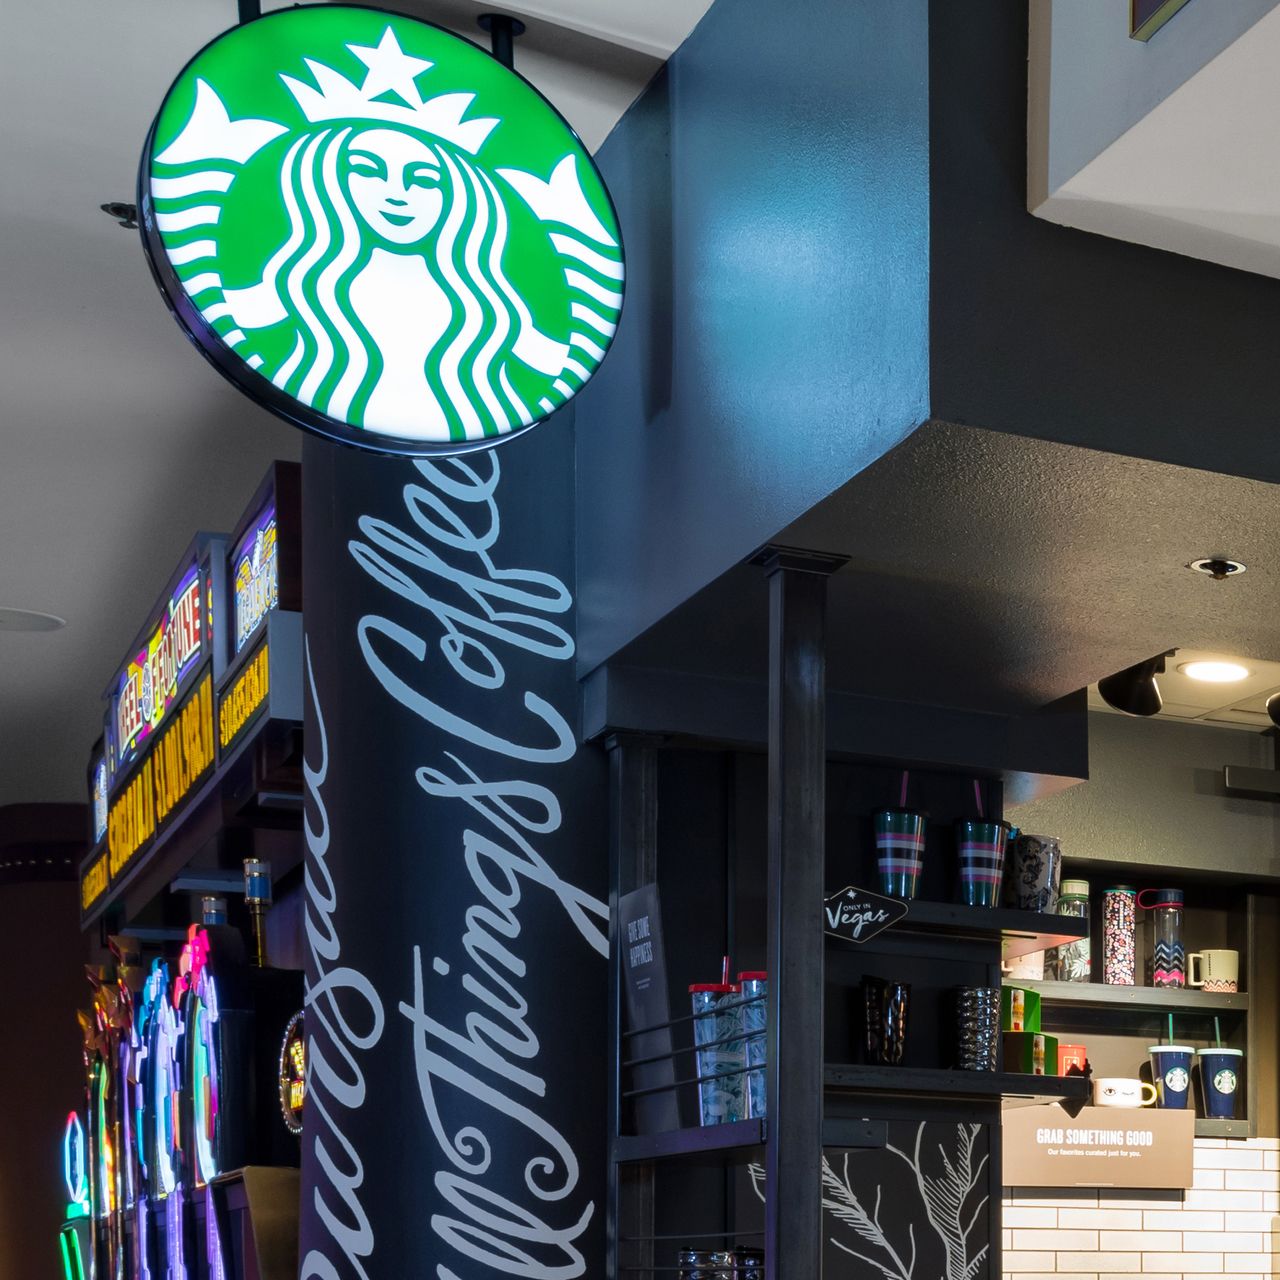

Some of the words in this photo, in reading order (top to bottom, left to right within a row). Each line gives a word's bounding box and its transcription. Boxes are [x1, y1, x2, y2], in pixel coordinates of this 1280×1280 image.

[348, 448, 577, 763] Coffee
[825, 901, 890, 938] Vegas
[843, 904, 860, 912] ONLY
[399, 752, 609, 1200] Things
[1036, 1128, 1064, 1144] GRAB
[1066, 1128, 1124, 1145] SOMETHING
[1126, 1130, 1153, 1146] GOOD
[1048, 1148, 1059, 1156] Our
[1060, 1148, 1084, 1156] favorites
[1085, 1149, 1108, 1157] curated
[1108, 1149, 1119, 1158] just
